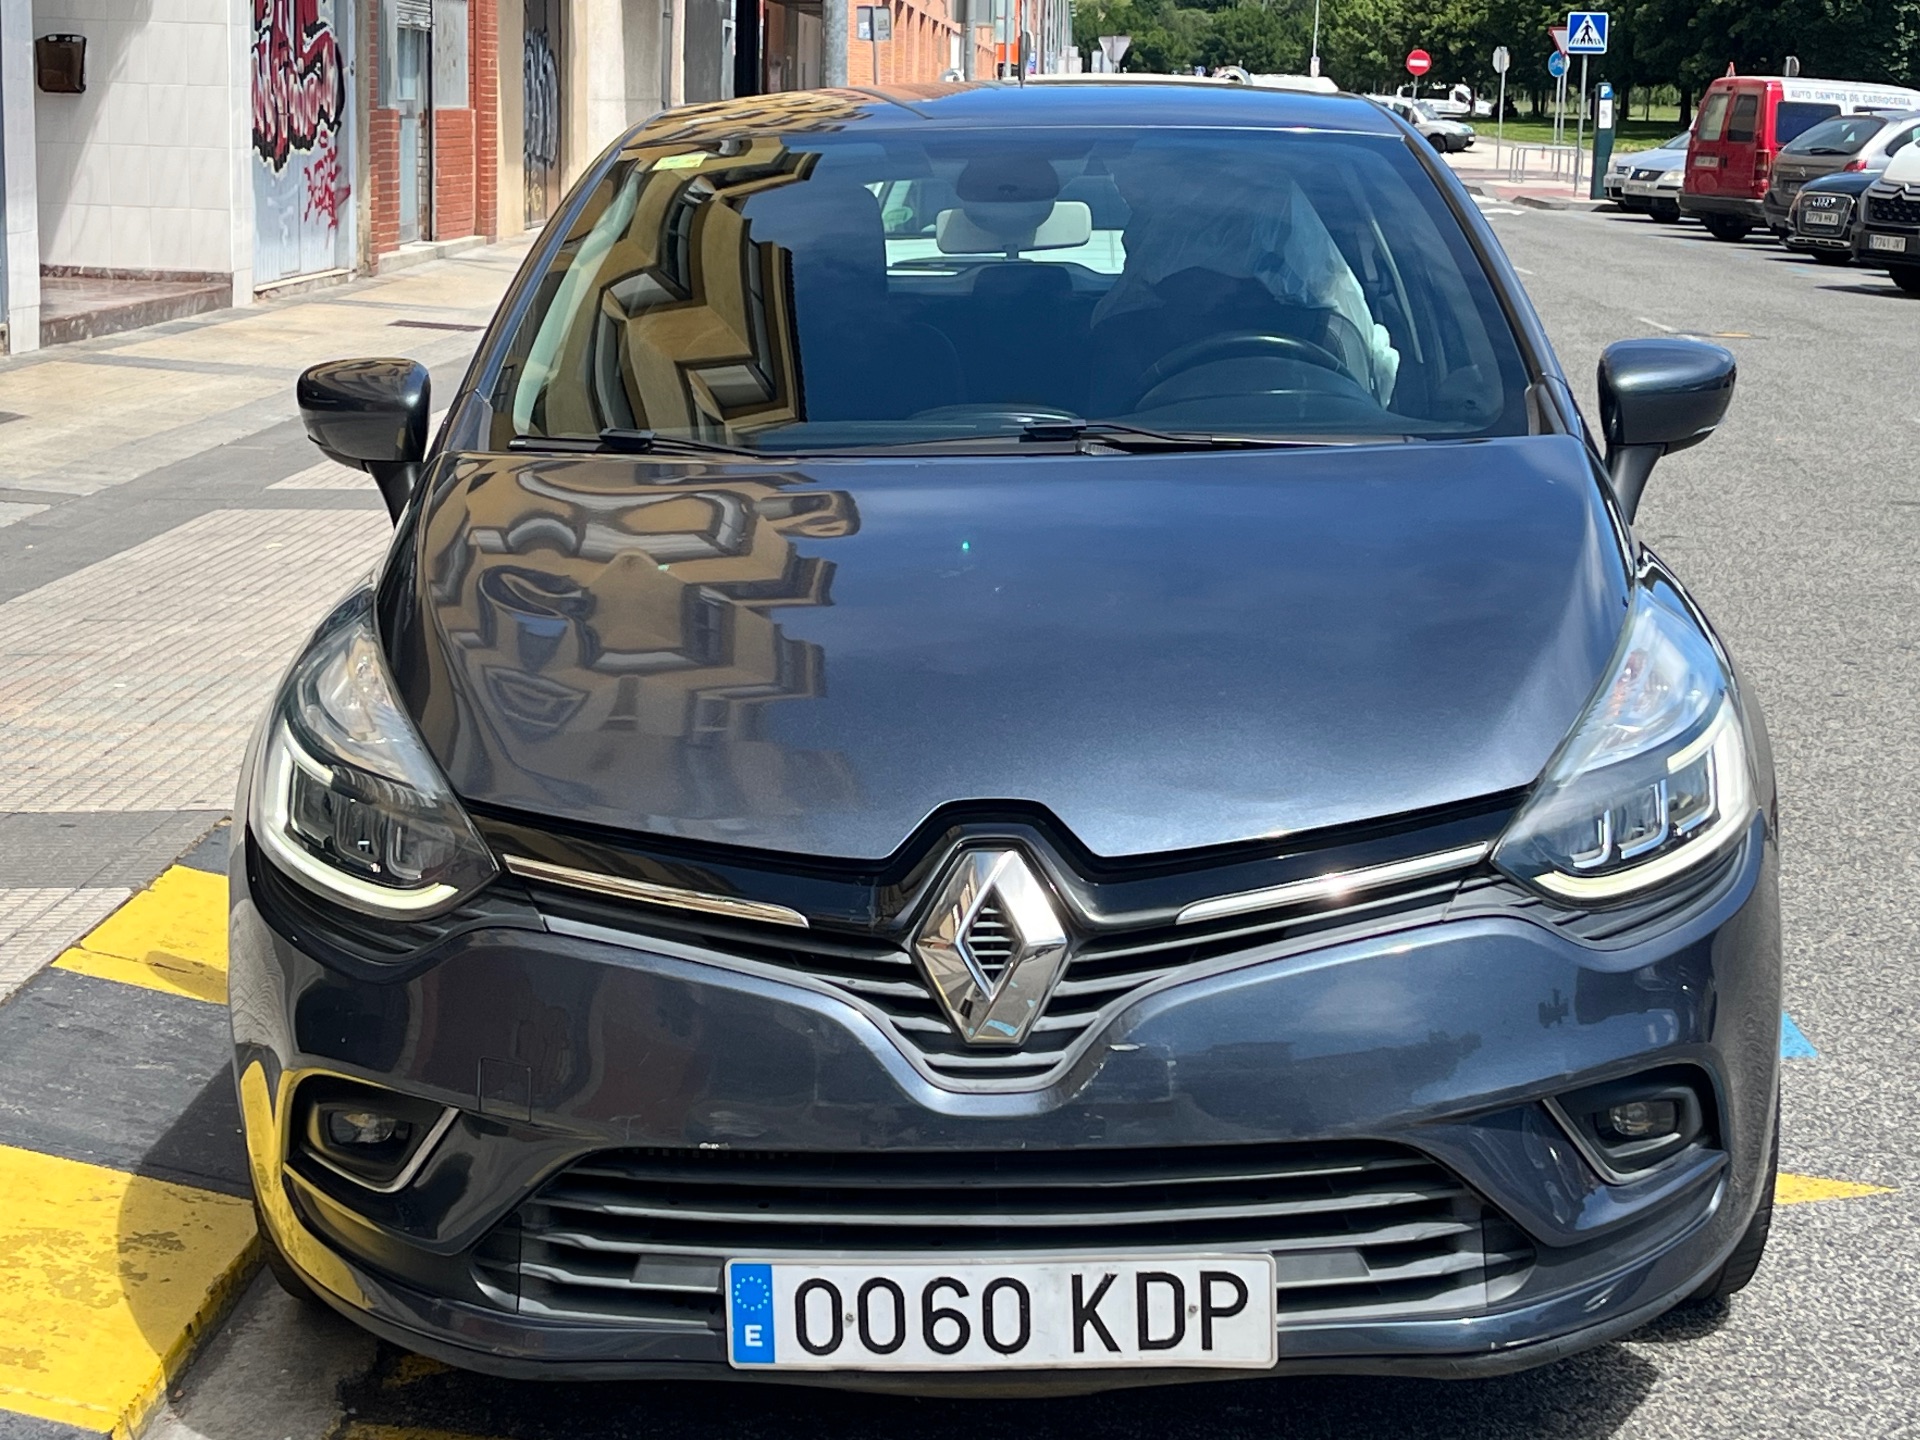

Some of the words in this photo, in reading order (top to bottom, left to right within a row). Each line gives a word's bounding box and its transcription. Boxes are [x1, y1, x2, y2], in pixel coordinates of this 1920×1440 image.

[1601, 86, 1610, 98] P
[1791, 90, 1811, 99] AUTO
[1815, 91, 1847, 101] CENTRO
[1849, 93, 1860, 102] DE
[794, 1276, 1032, 1356] 0060
[1071, 1270, 1249, 1353] KDP
[744, 1324, 763, 1348] E
